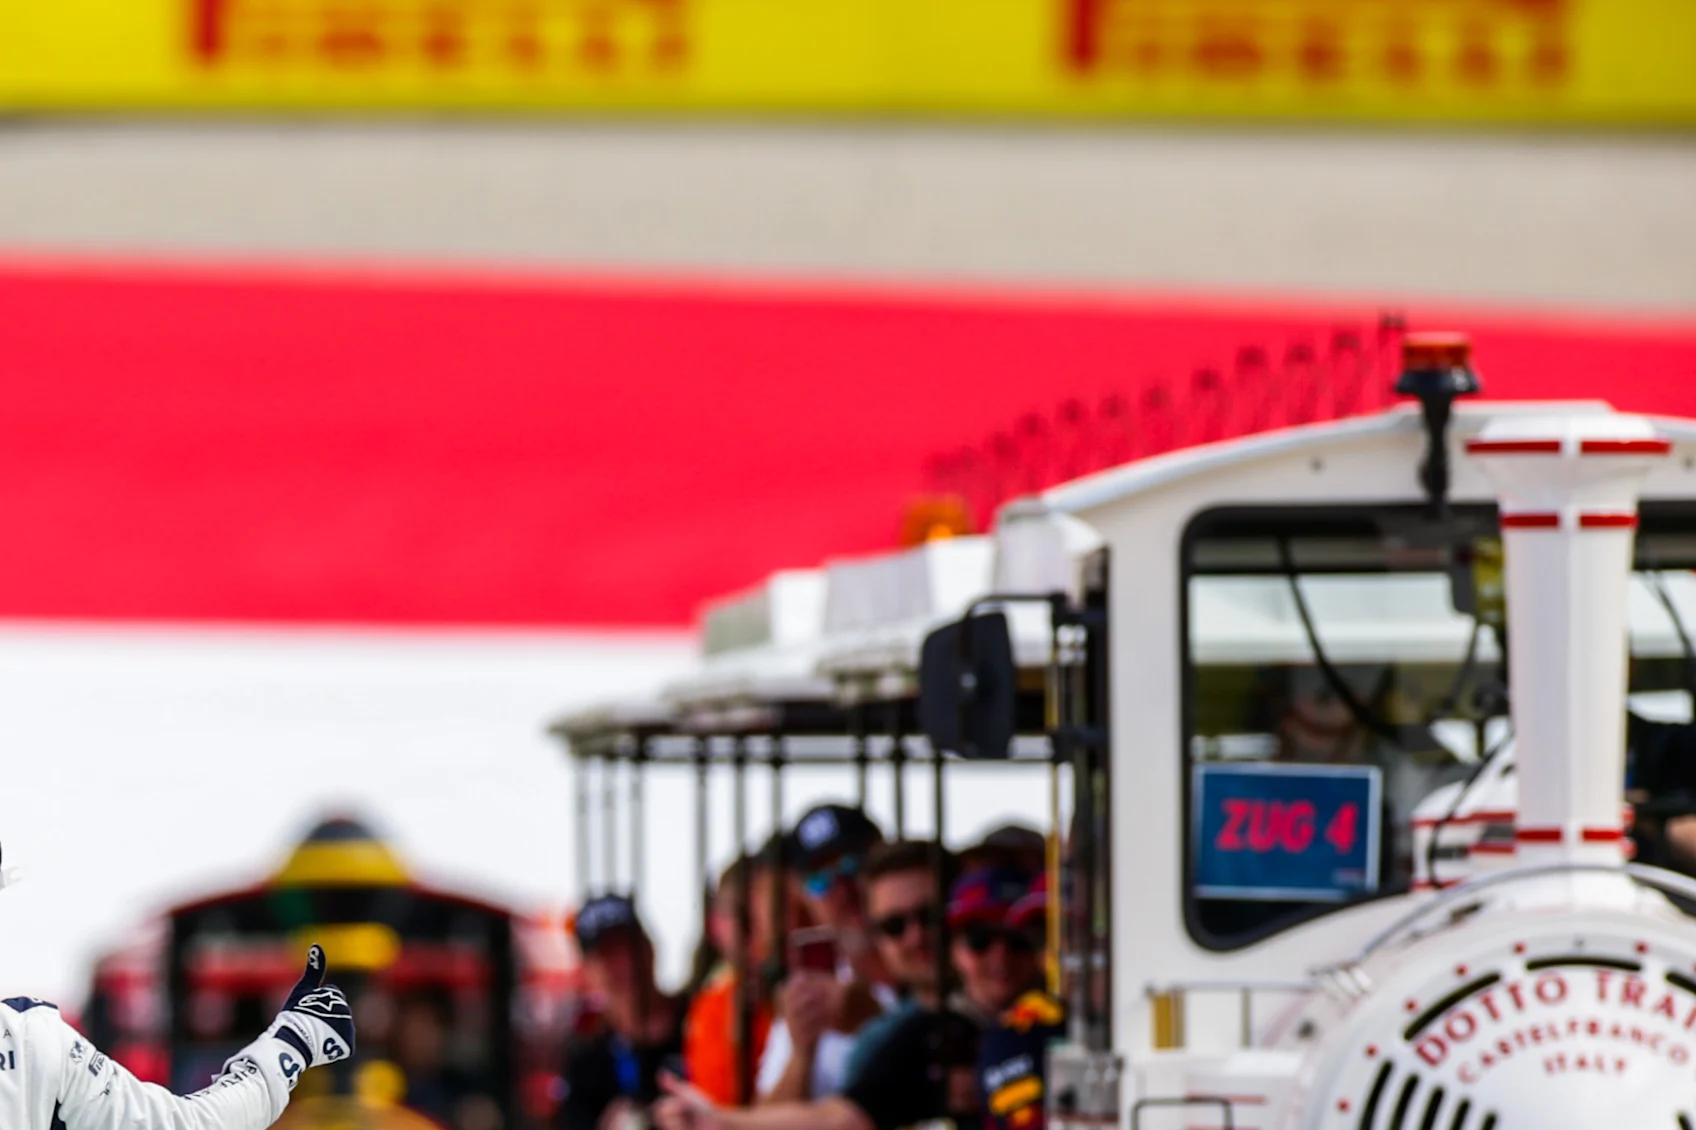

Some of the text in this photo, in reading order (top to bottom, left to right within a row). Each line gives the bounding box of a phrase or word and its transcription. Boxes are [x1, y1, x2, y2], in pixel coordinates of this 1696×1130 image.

[1215, 797, 1358, 855] ZUG 4
[1416, 972, 1567, 1067] DOTTO
[1543, 1051, 1628, 1075] ITALY
